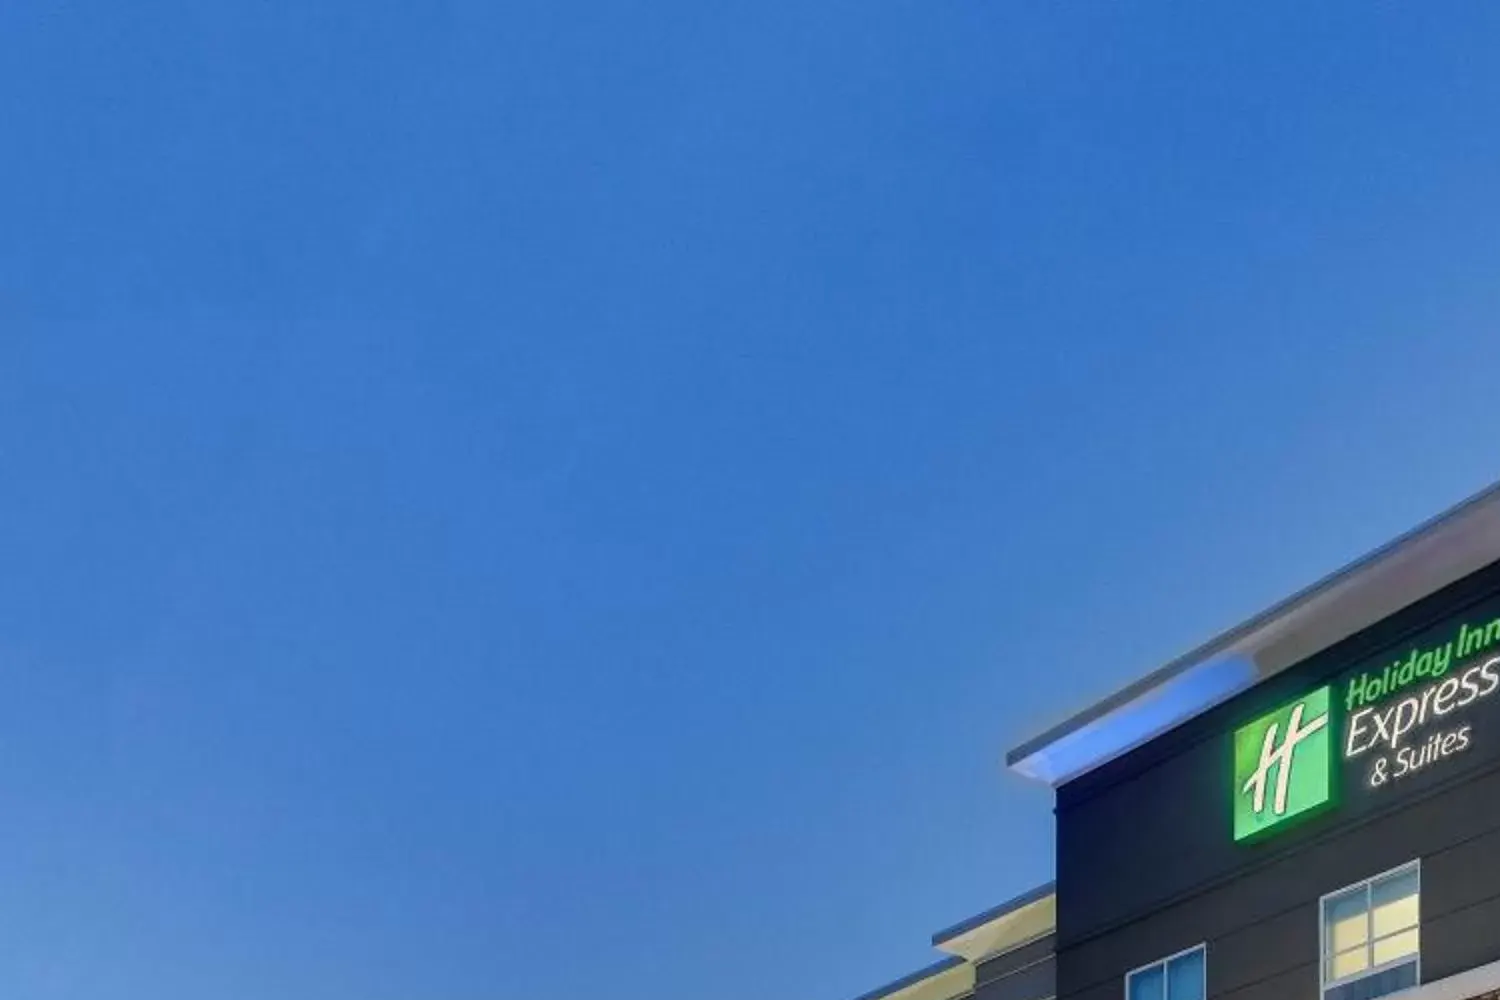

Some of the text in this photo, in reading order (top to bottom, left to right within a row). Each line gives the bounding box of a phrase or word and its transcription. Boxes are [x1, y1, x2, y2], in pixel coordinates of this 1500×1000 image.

[1346, 642, 1451, 709] Holiday
[1370, 725, 1472, 787] & Suites
